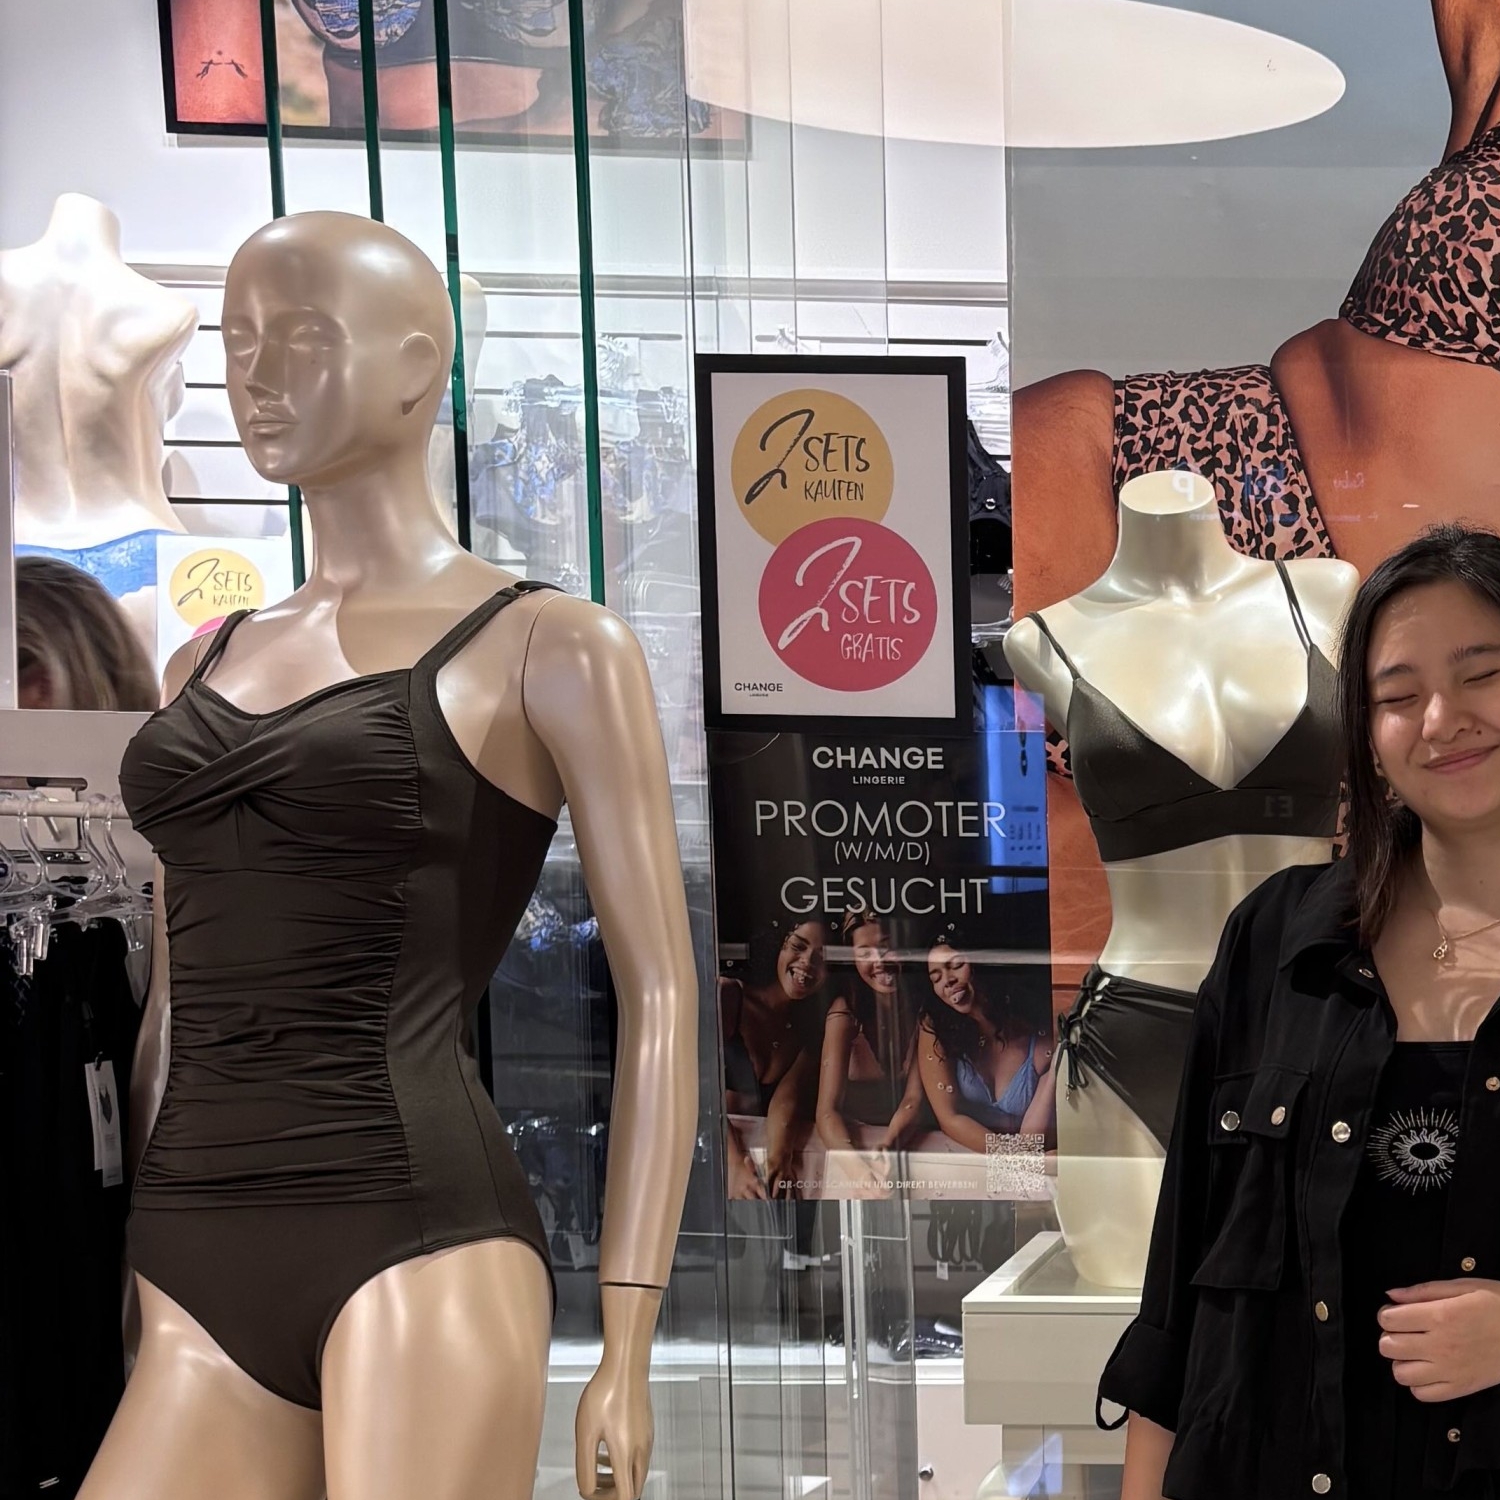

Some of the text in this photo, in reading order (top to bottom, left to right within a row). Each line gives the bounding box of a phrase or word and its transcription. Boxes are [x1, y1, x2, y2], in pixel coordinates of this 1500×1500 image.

[745, 408, 870, 505] 2 SETS
[804, 479, 864, 503] KAUFEN
[177, 557, 253, 607] 2 SETS
[778, 536, 921, 650] 2 SETS
[840, 632, 904, 663] GRATIS
[734, 682, 784, 692] CHANGE
[812, 746, 945, 770] CHANGE
[852, 775, 906, 785] LINGERIE
[755, 799, 1007, 838] PROMOTER
[834, 840, 931, 866] (W/M/D)
[780, 876, 989, 915] GESUCHT
[896, 1180, 926, 1189] DIREKT
